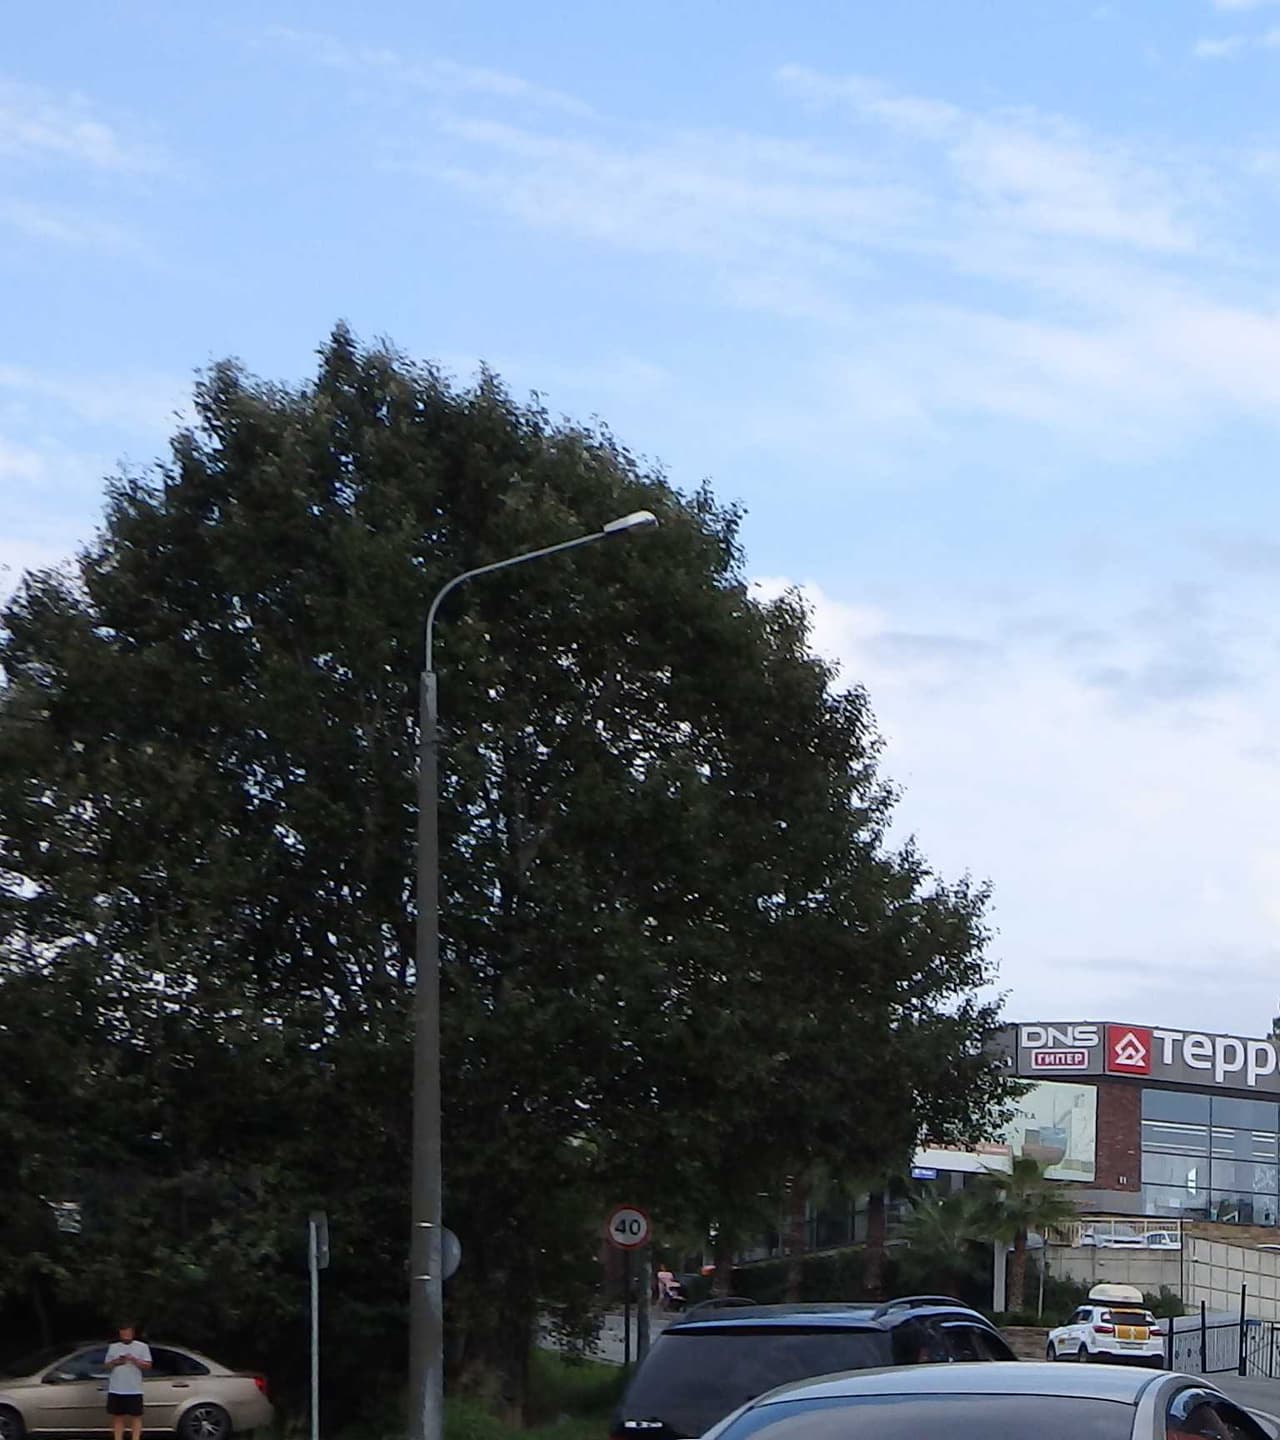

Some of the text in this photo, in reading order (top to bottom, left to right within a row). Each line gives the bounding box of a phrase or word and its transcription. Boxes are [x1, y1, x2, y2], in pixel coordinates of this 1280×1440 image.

[1021, 1026, 1099, 1047] DNS
[1037, 1053, 1083, 1065] ГИПЕР
[614, 1219, 641, 1235] 40
